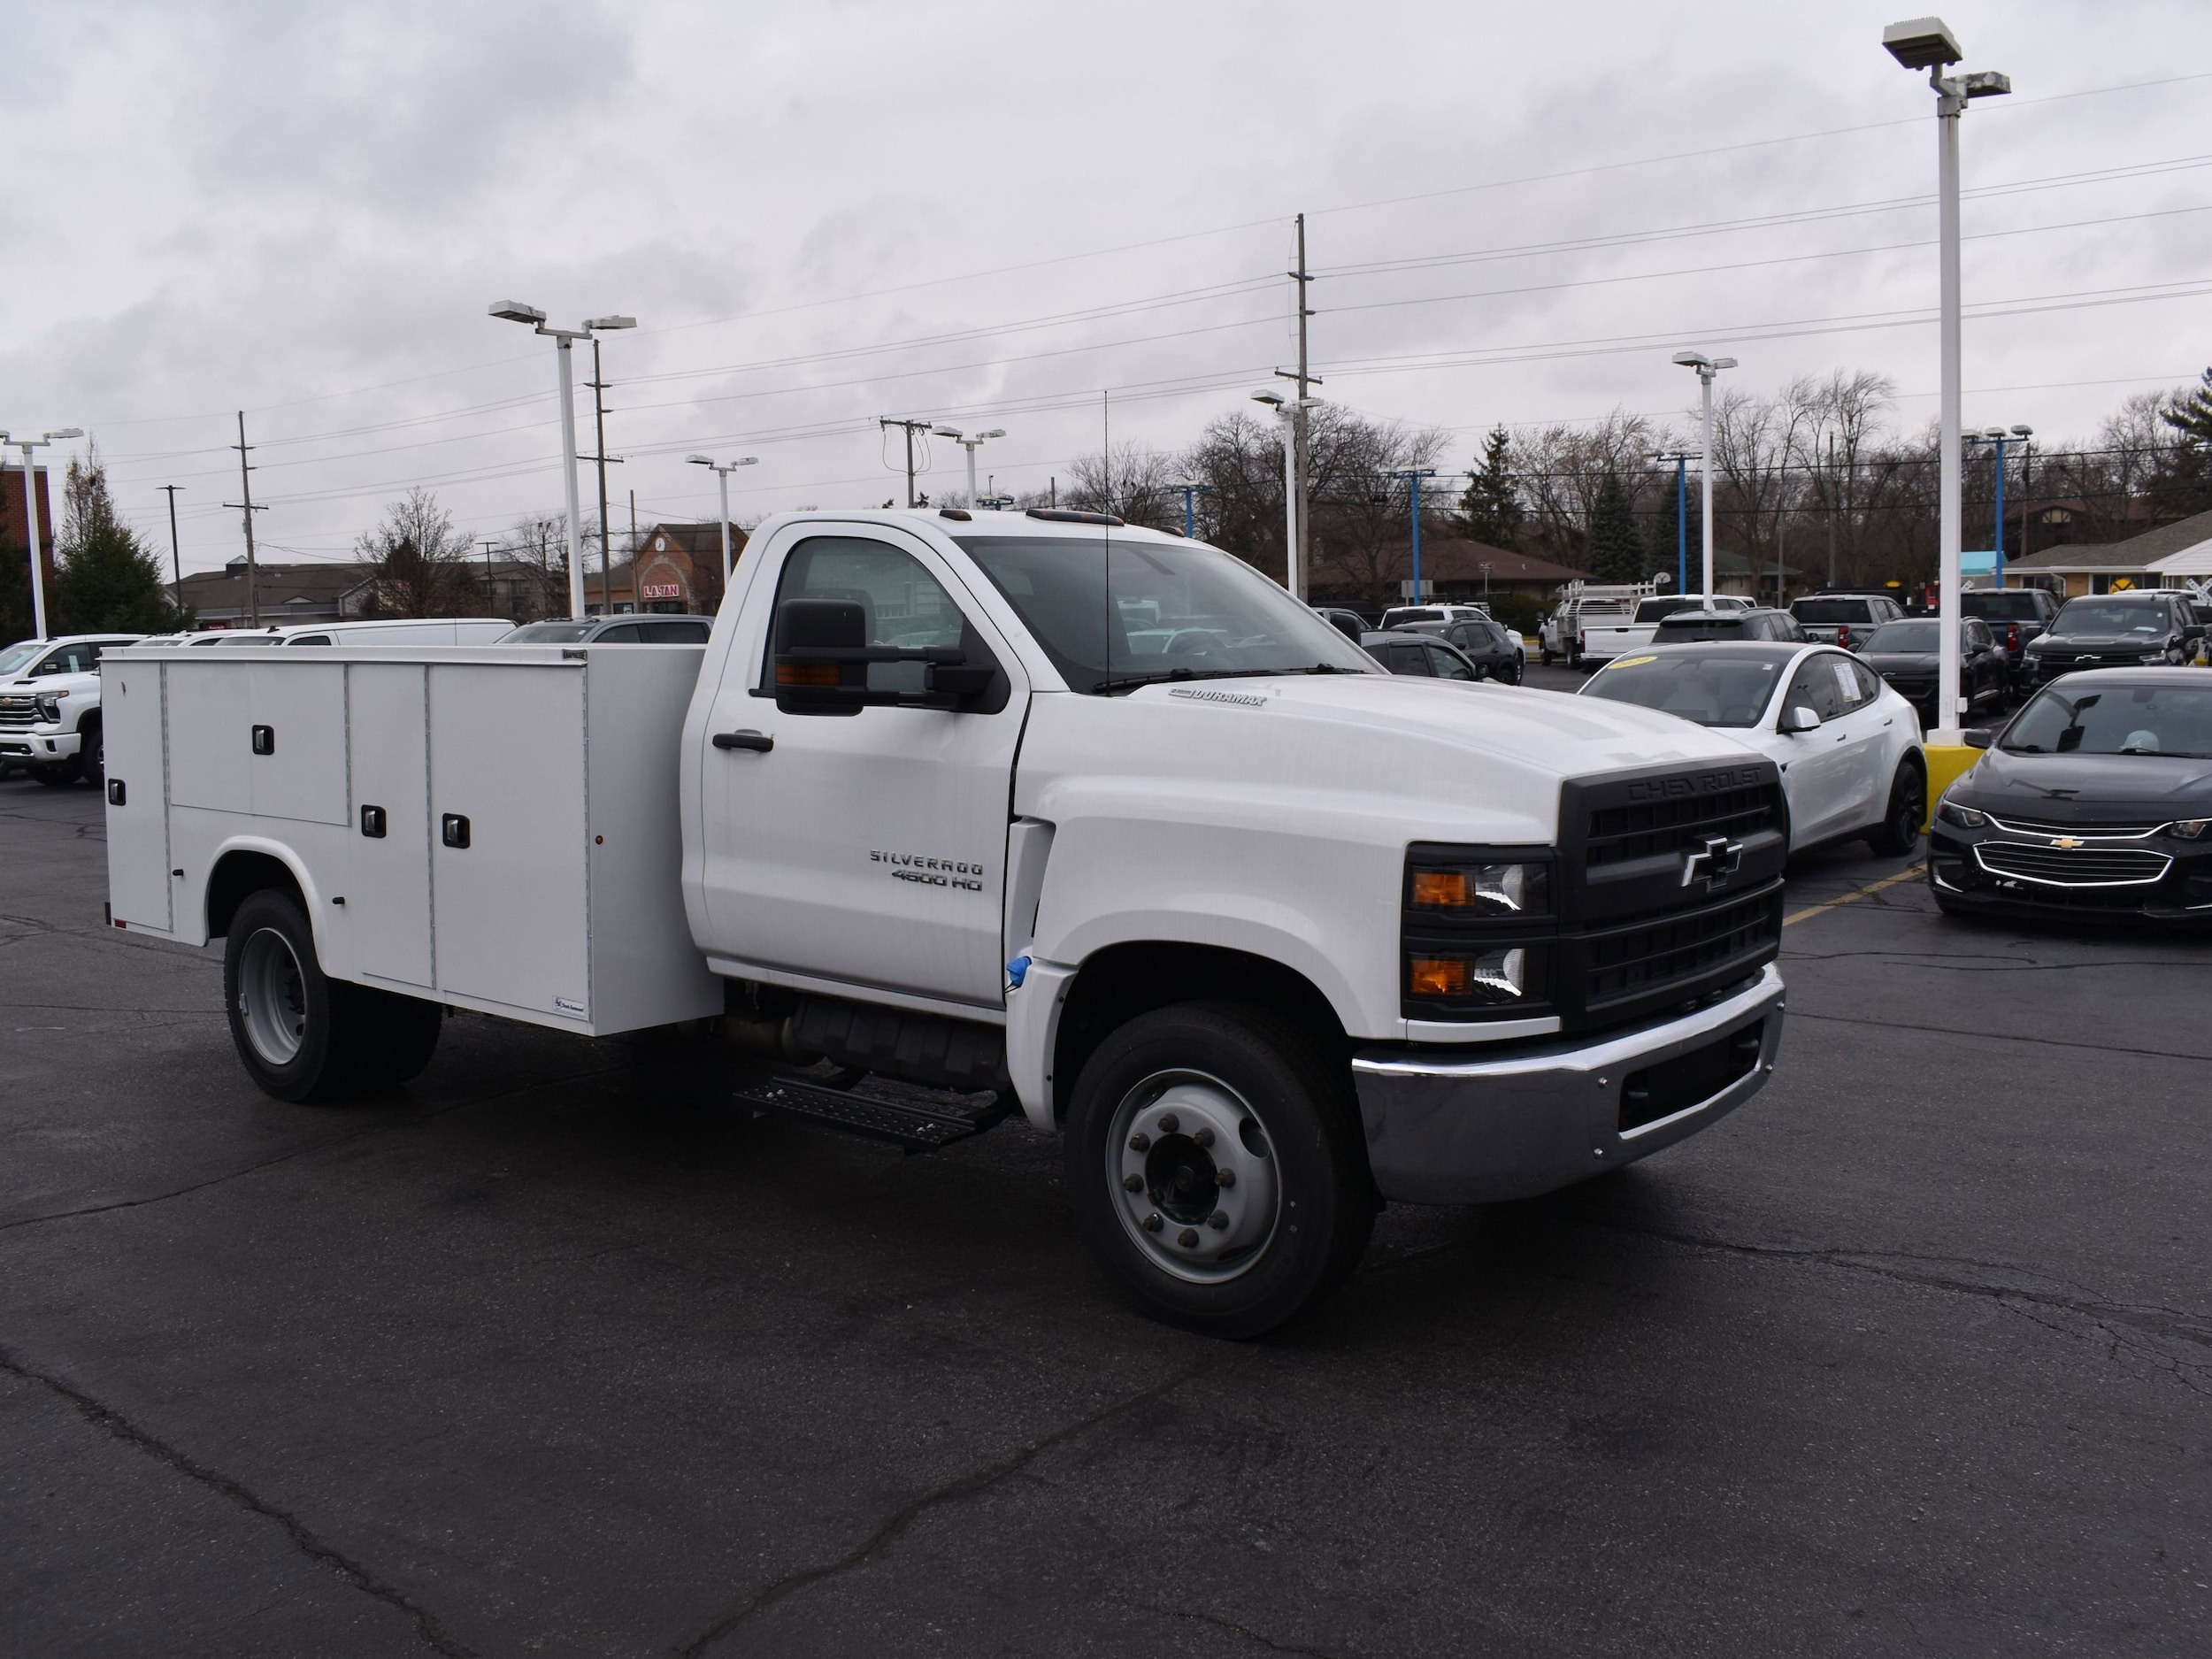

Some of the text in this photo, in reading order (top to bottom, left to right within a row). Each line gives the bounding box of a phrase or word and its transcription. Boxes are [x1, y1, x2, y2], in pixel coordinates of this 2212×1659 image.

[659, 585, 679, 596] TAN
[1193, 690, 1267, 706] DURAMAX
[1628, 767, 1761, 801] CHEVROLET
[871, 849, 983, 875] SILVERADO
[892, 870, 983, 891] 4500 HD
